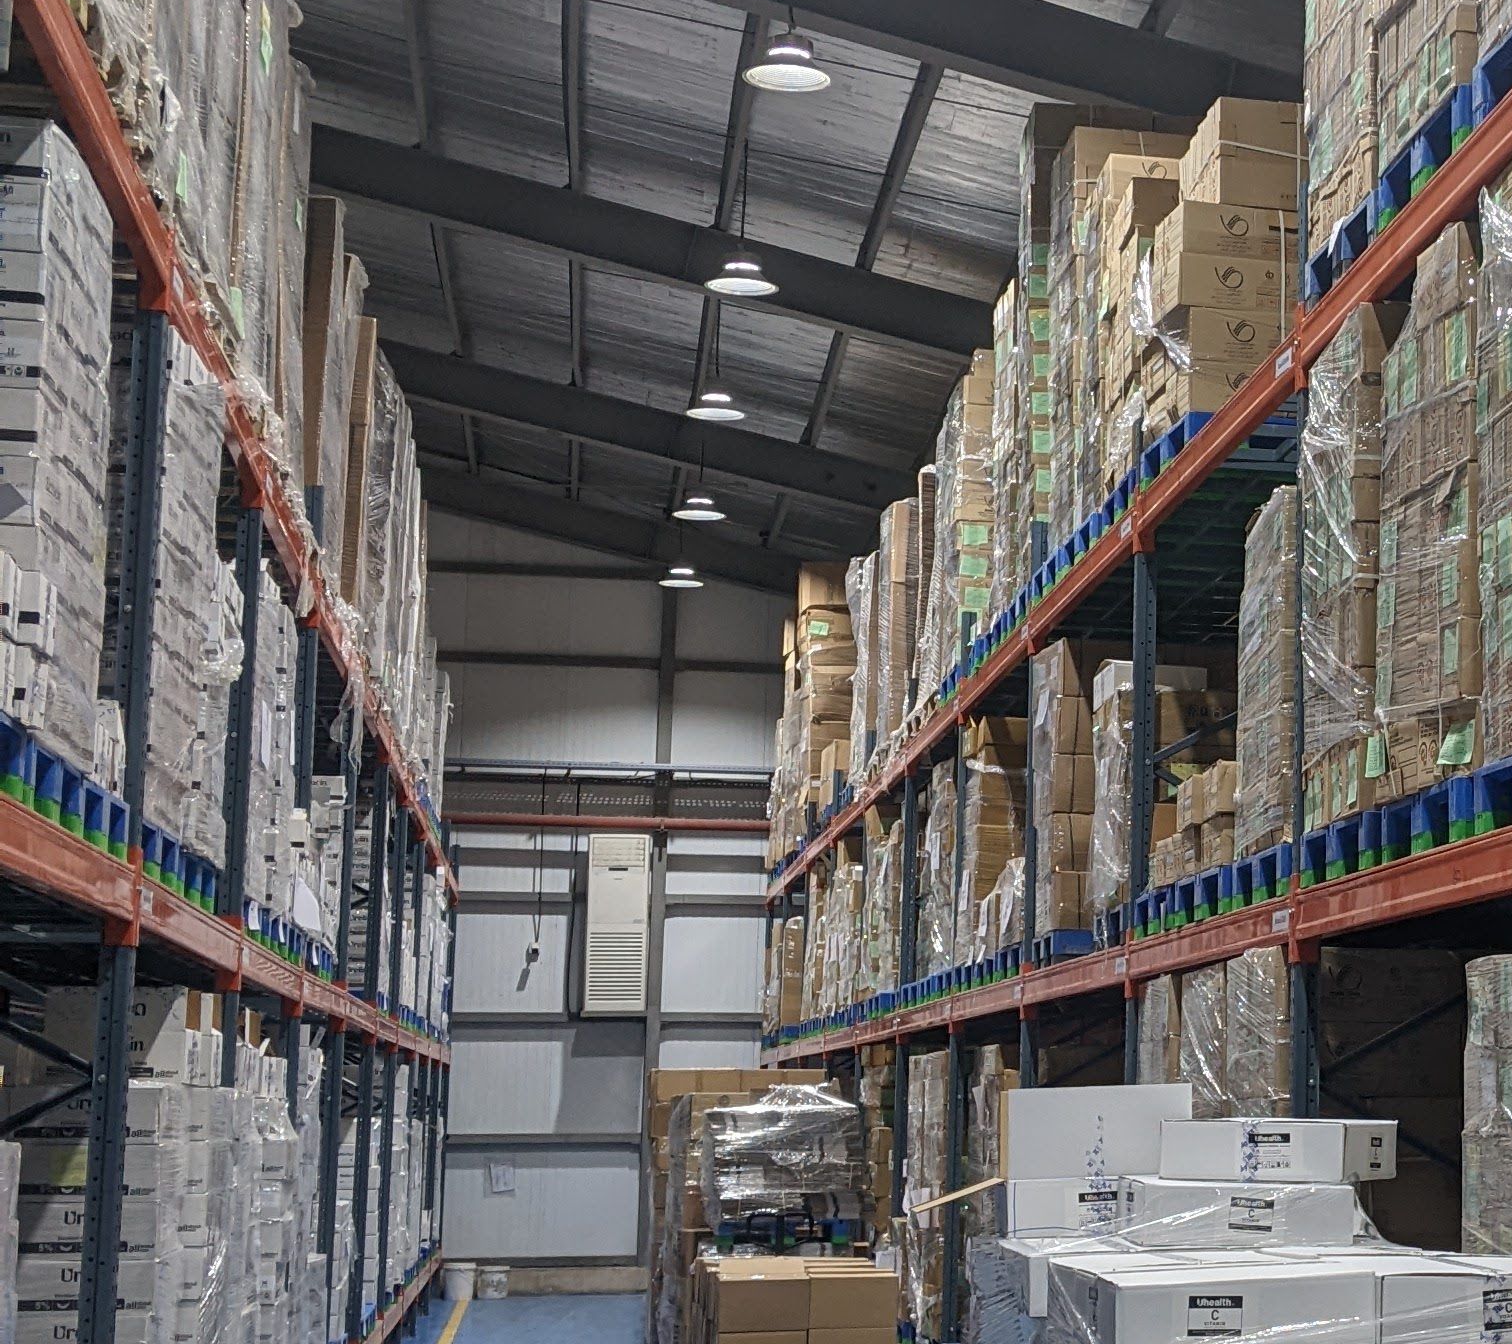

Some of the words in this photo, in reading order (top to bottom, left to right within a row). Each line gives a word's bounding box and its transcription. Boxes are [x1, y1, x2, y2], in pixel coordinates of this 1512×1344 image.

[1248, 1209, 1255, 1218] C
[1196, 1298, 1235, 1307] Uhealth
[1505, 1303, 1512, 1313] C
[1211, 1310, 1219, 1320] C
